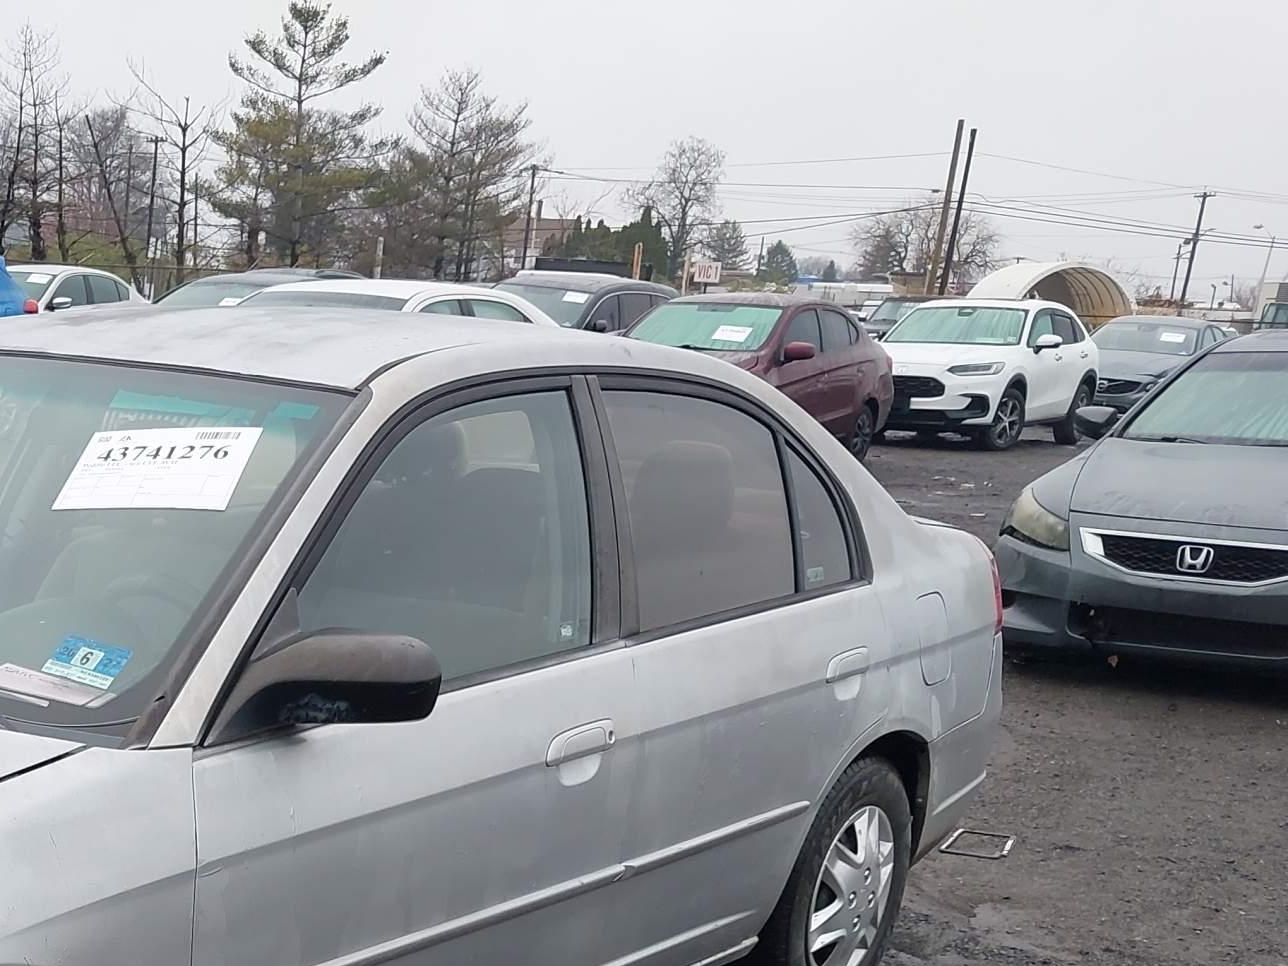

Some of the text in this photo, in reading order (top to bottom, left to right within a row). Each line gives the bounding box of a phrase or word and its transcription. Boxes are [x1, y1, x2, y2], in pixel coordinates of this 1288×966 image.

[697, 264, 713, 279] VIC
[97, 445, 231, 462] 43741276
[78, 651, 95, 667] 6
